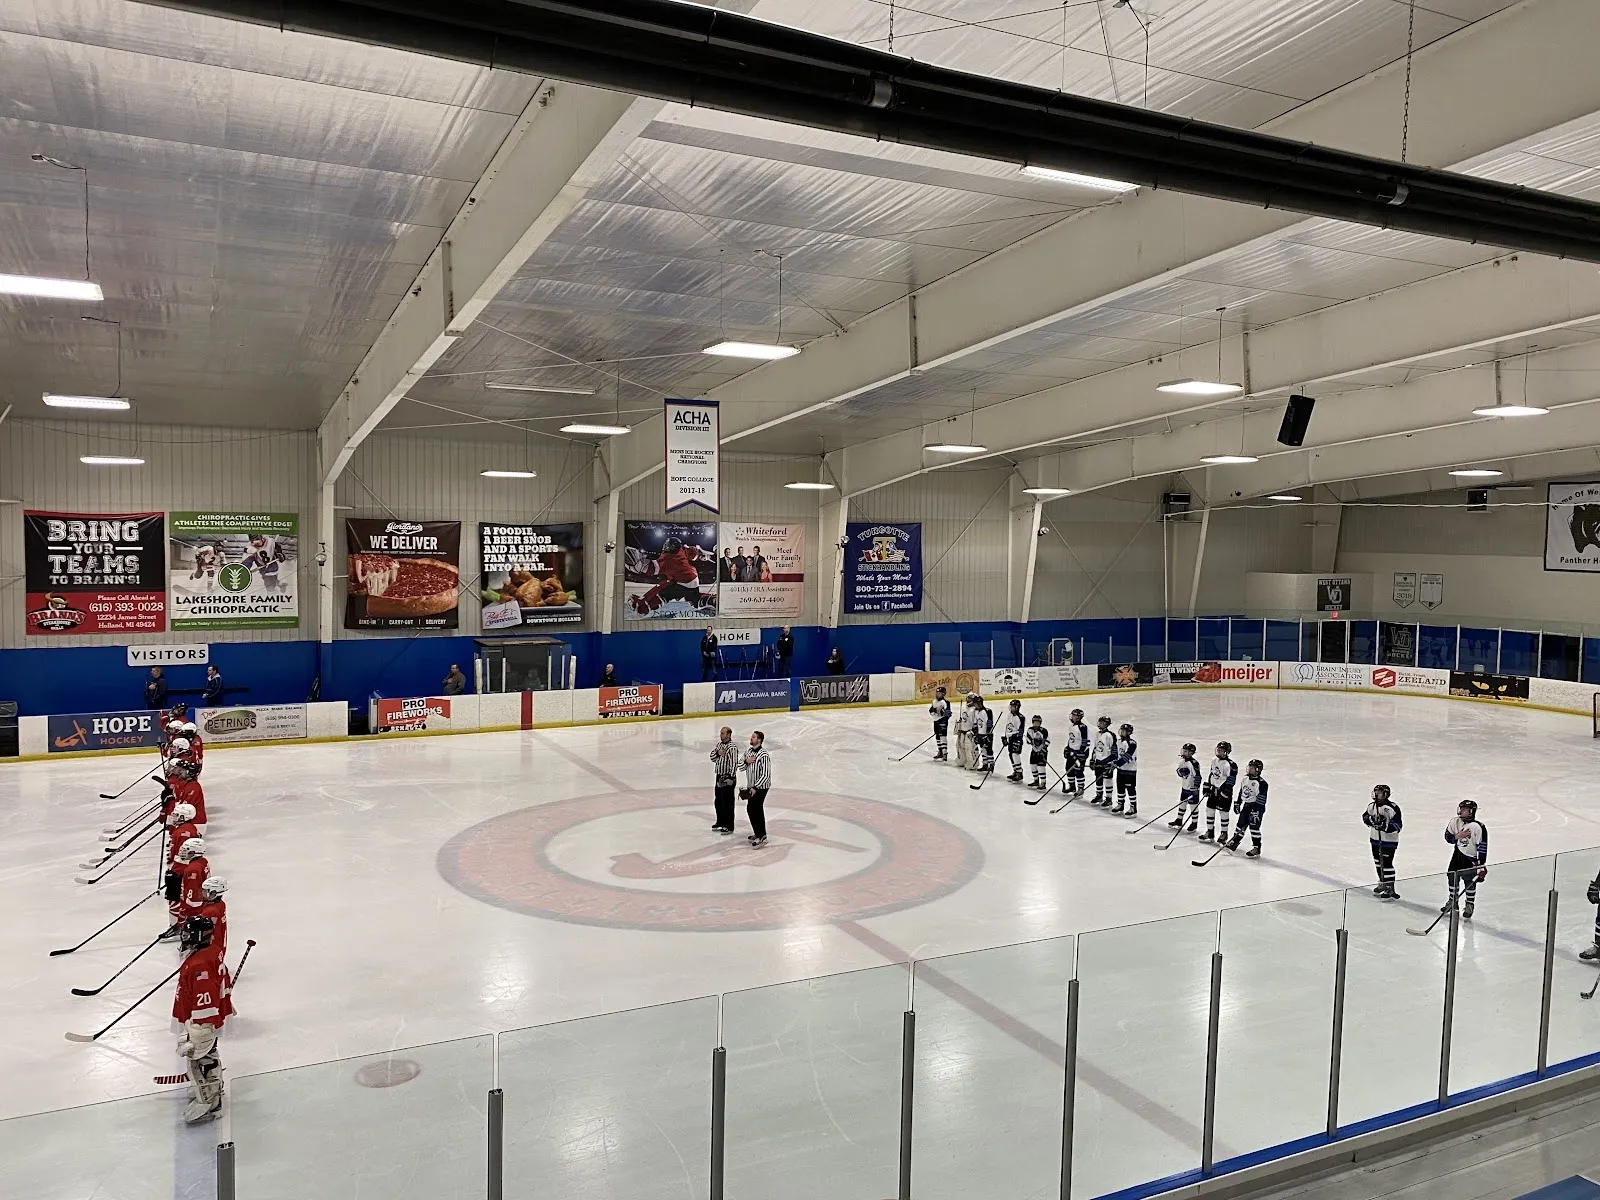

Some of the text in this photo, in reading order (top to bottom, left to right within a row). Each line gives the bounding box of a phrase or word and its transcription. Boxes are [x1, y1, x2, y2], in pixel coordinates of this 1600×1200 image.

[674, 410, 711, 425] ACHA
[1552, 496, 1573, 510] Hme
[47, 520, 140, 541] BRING
[493, 527, 536, 536] FOODIE,
[746, 527, 787, 536] Whiteford
[857, 526, 910, 542] TURCOTTE
[370, 536, 438, 550] WE DELIVER
[493, 536, 522, 544] BEER
[523, 536, 552, 544] SNOB
[73, 543, 114, 554] YOUR
[519, 545, 559, 553] SPORTS
[507, 554, 539, 562] WALK
[48, 555, 140, 573] TEAMS
[522, 563, 553, 571] BAR...
[49, 575, 140, 584] TO BRANN'S!
[877, 574, 891, 583] Your
[176, 596, 246, 604] LAKESHORE
[89, 602, 164, 612] (616) 393-0028
[191, 605, 280, 614] CHIROPRACTIC
[720, 633, 750, 641] HOME
[132, 650, 206, 660] VISITORS
[1222, 664, 1272, 682] meijer
[920, 677, 950, 692] LASER TAG
[1398, 676, 1446, 686] ZEELAND
[620, 689, 637, 697] PRO
[822, 681, 868, 698] HOCKEY
[403, 700, 424, 709] PRO
[606, 695, 652, 707] FIREWORKS
[387, 707, 443, 720] FIREWORKS
[93, 716, 151, 734] HOPE
[101, 736, 143, 744] HOCKEY
[187, 890, 193, 898] 8
[197, 992, 211, 1006] 20
